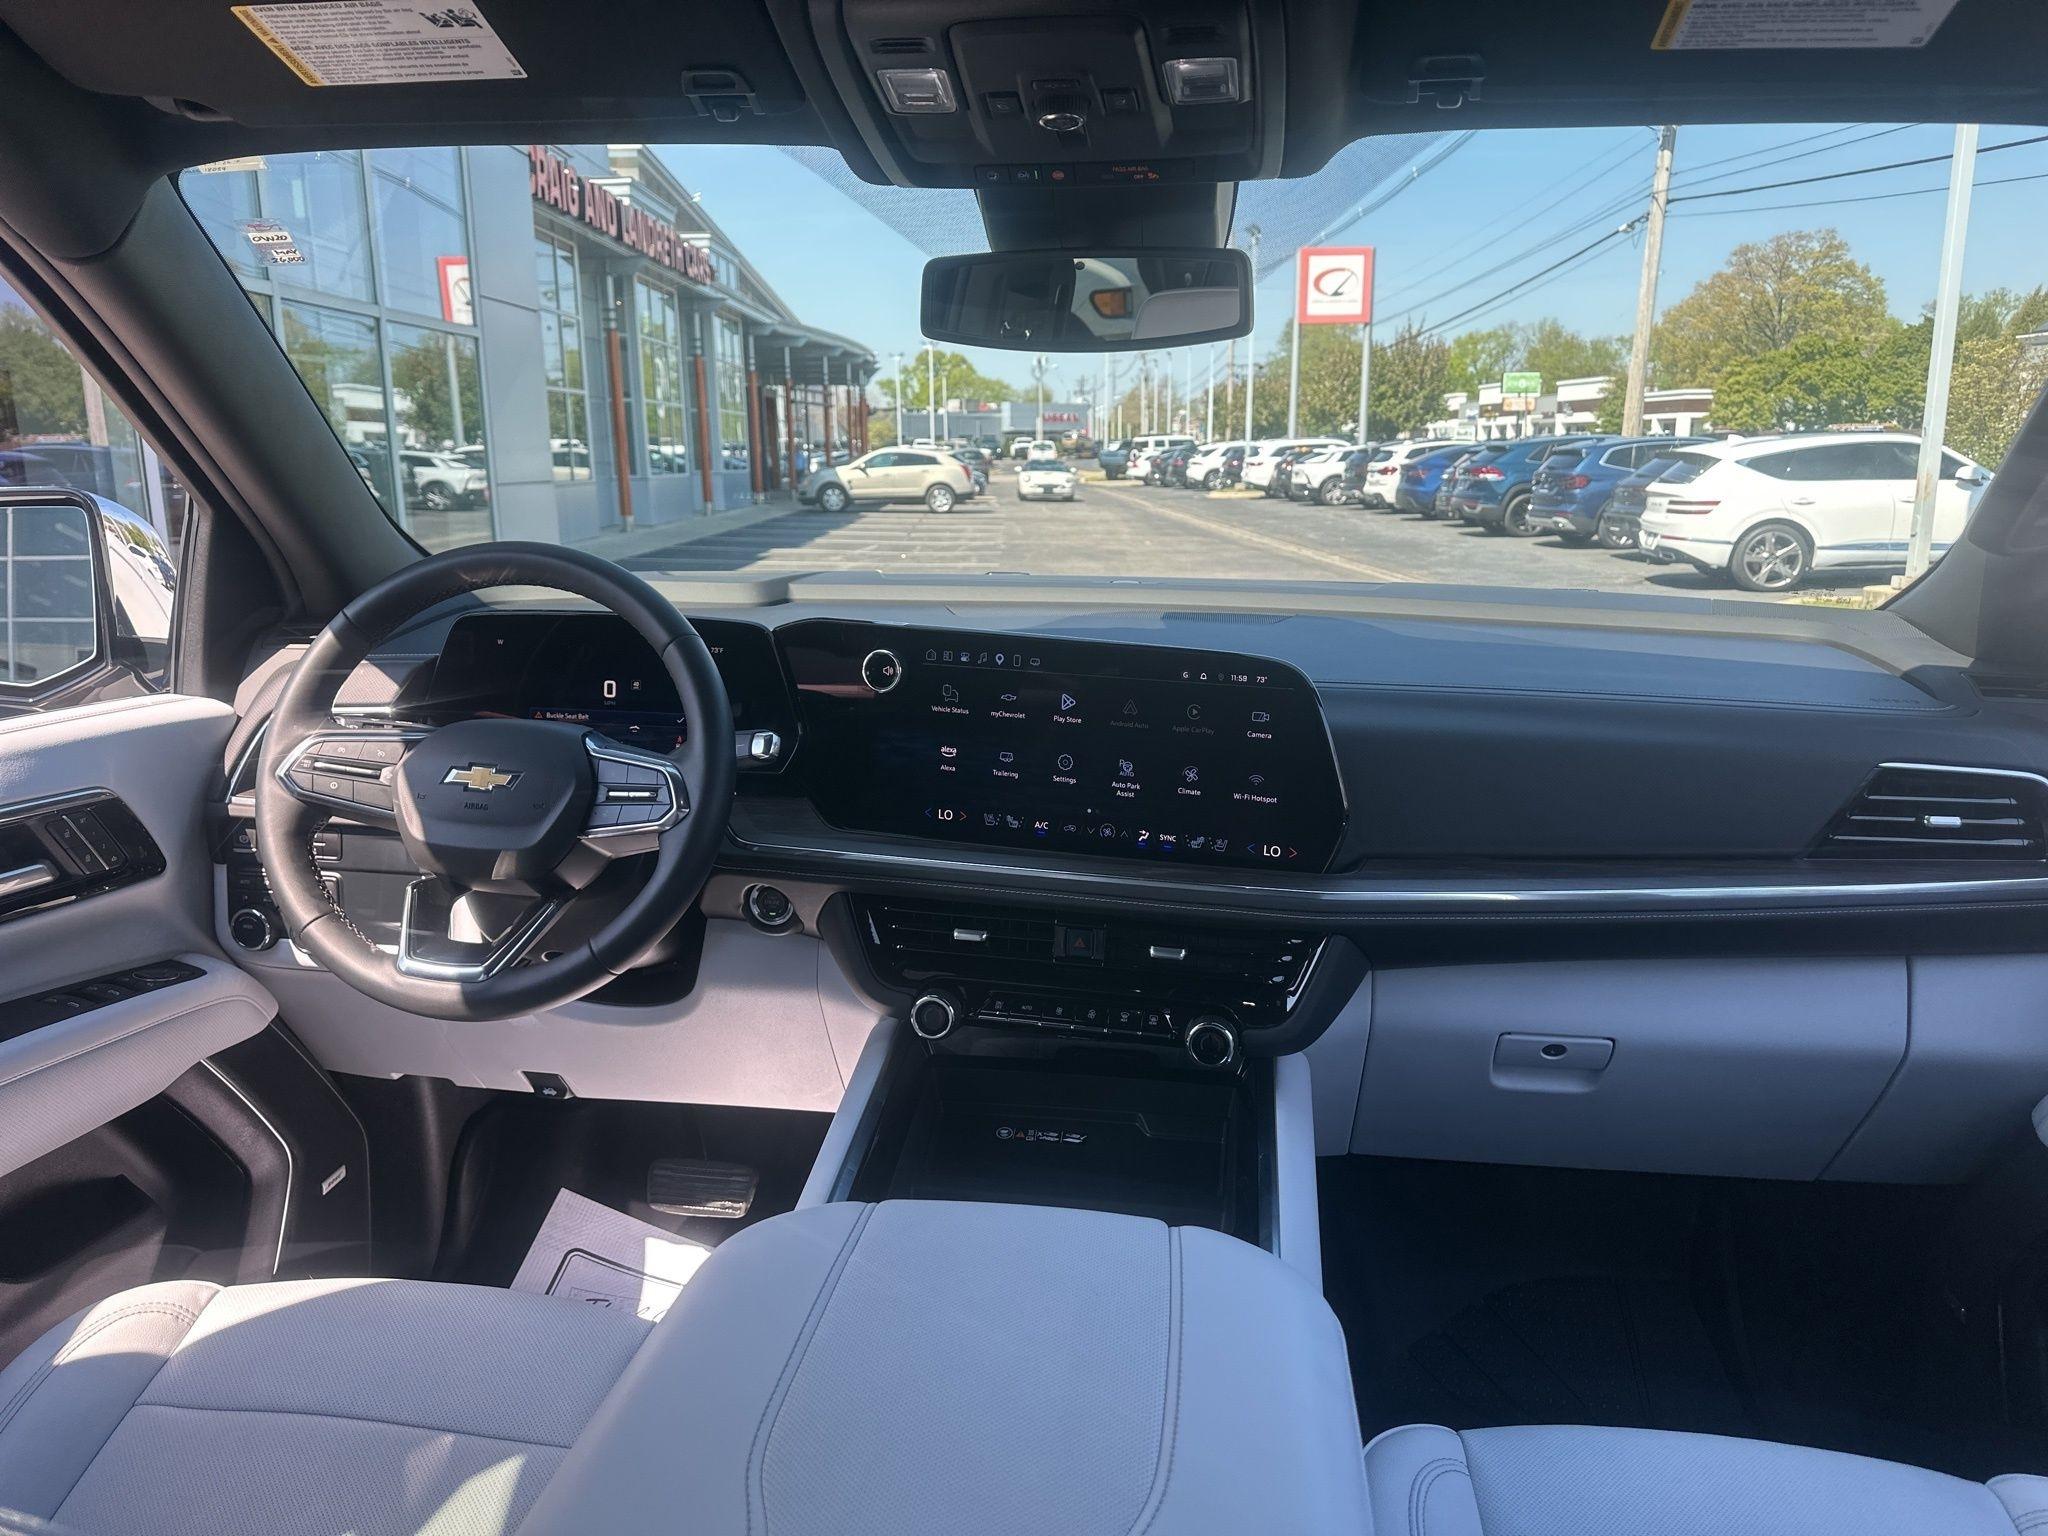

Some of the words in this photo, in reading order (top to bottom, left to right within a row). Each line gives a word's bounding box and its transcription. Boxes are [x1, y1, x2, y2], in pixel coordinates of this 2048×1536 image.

[584, 176, 617, 237] AND
[603, 680, 616, 698] 0
[931, 705, 950, 713] Vehicle
[990, 711, 1026, 719] myChevrolet
[1053, 715, 1065, 723] Play
[1110, 720, 1134, 728] Android
[1172, 725, 1190, 734] Apple
[1191, 726, 1216, 736] CarPlay
[1247, 731, 1272, 739] Camera
[940, 764, 956, 772] Alexa
[993, 769, 1019, 779] Trailering
[1052, 775, 1077, 784] Settings
[1111, 781, 1126, 789] Auto
[1127, 782, 1141, 790] Park
[1115, 790, 1135, 798] Assist
[1178, 787, 1201, 795] Climate
[1233, 792, 1250, 800] Wi-Fi
[1251, 794, 1277, 804] Hotspot
[938, 809, 953, 821] LO
[1034, 821, 1048, 829] A/C
[1159, 833, 1176, 842] SYNC
[1263, 845, 1281, 857] LO
